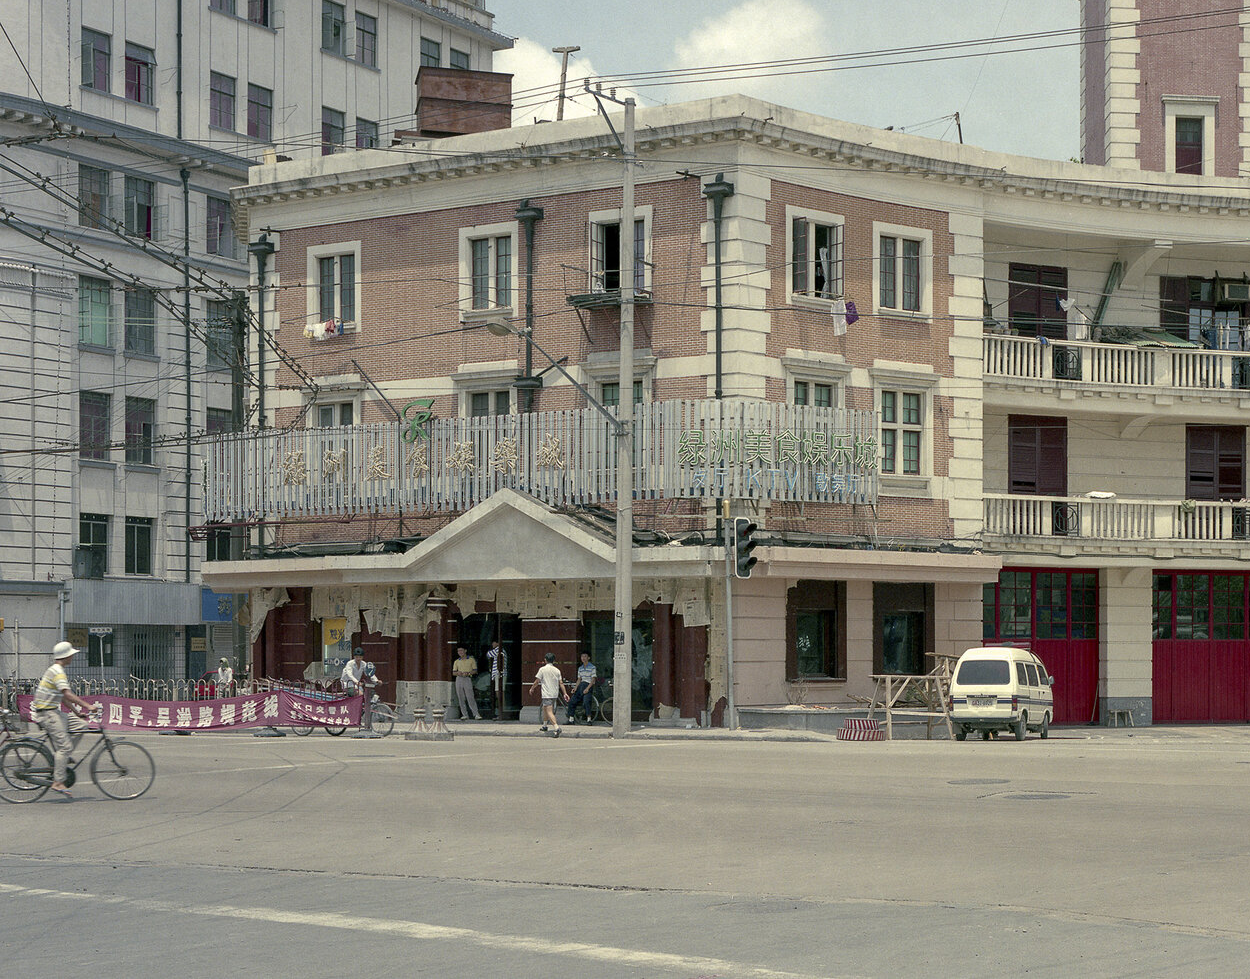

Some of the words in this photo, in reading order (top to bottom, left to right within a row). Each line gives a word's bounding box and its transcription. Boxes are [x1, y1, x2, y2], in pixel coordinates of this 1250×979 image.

[678, 428, 879, 470] 绿洲美食娱乐城
[746, 469, 799, 491] KTV
[815, 472, 861, 494] 歌舞厅
